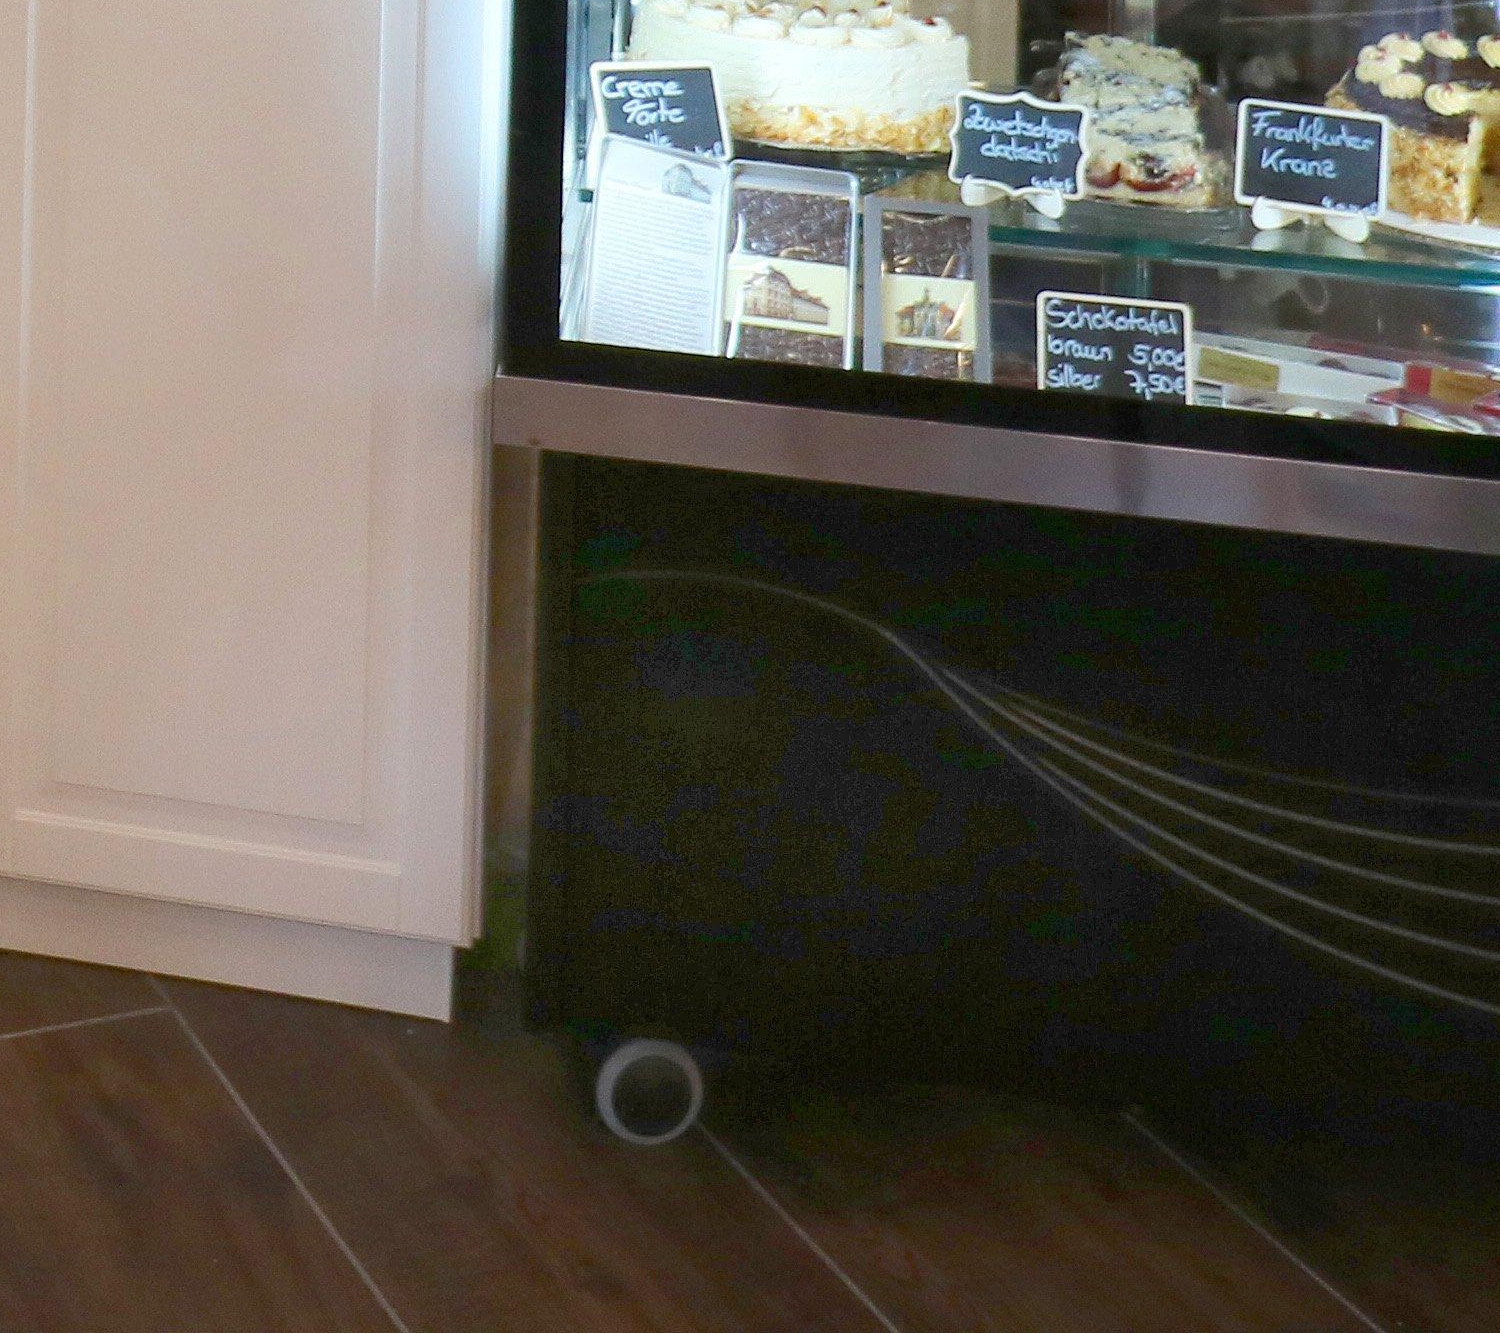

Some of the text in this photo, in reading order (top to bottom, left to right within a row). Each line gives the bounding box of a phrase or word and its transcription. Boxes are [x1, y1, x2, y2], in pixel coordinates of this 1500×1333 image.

[601, 75, 686, 100] Creme
[621, 96, 688, 127] Torte
[1251, 109, 1376, 152] Frankfurter
[1260, 146, 1338, 180] Kranz
[1048, 334, 1114, 362] braun
[1045, 363, 1103, 391] silber
